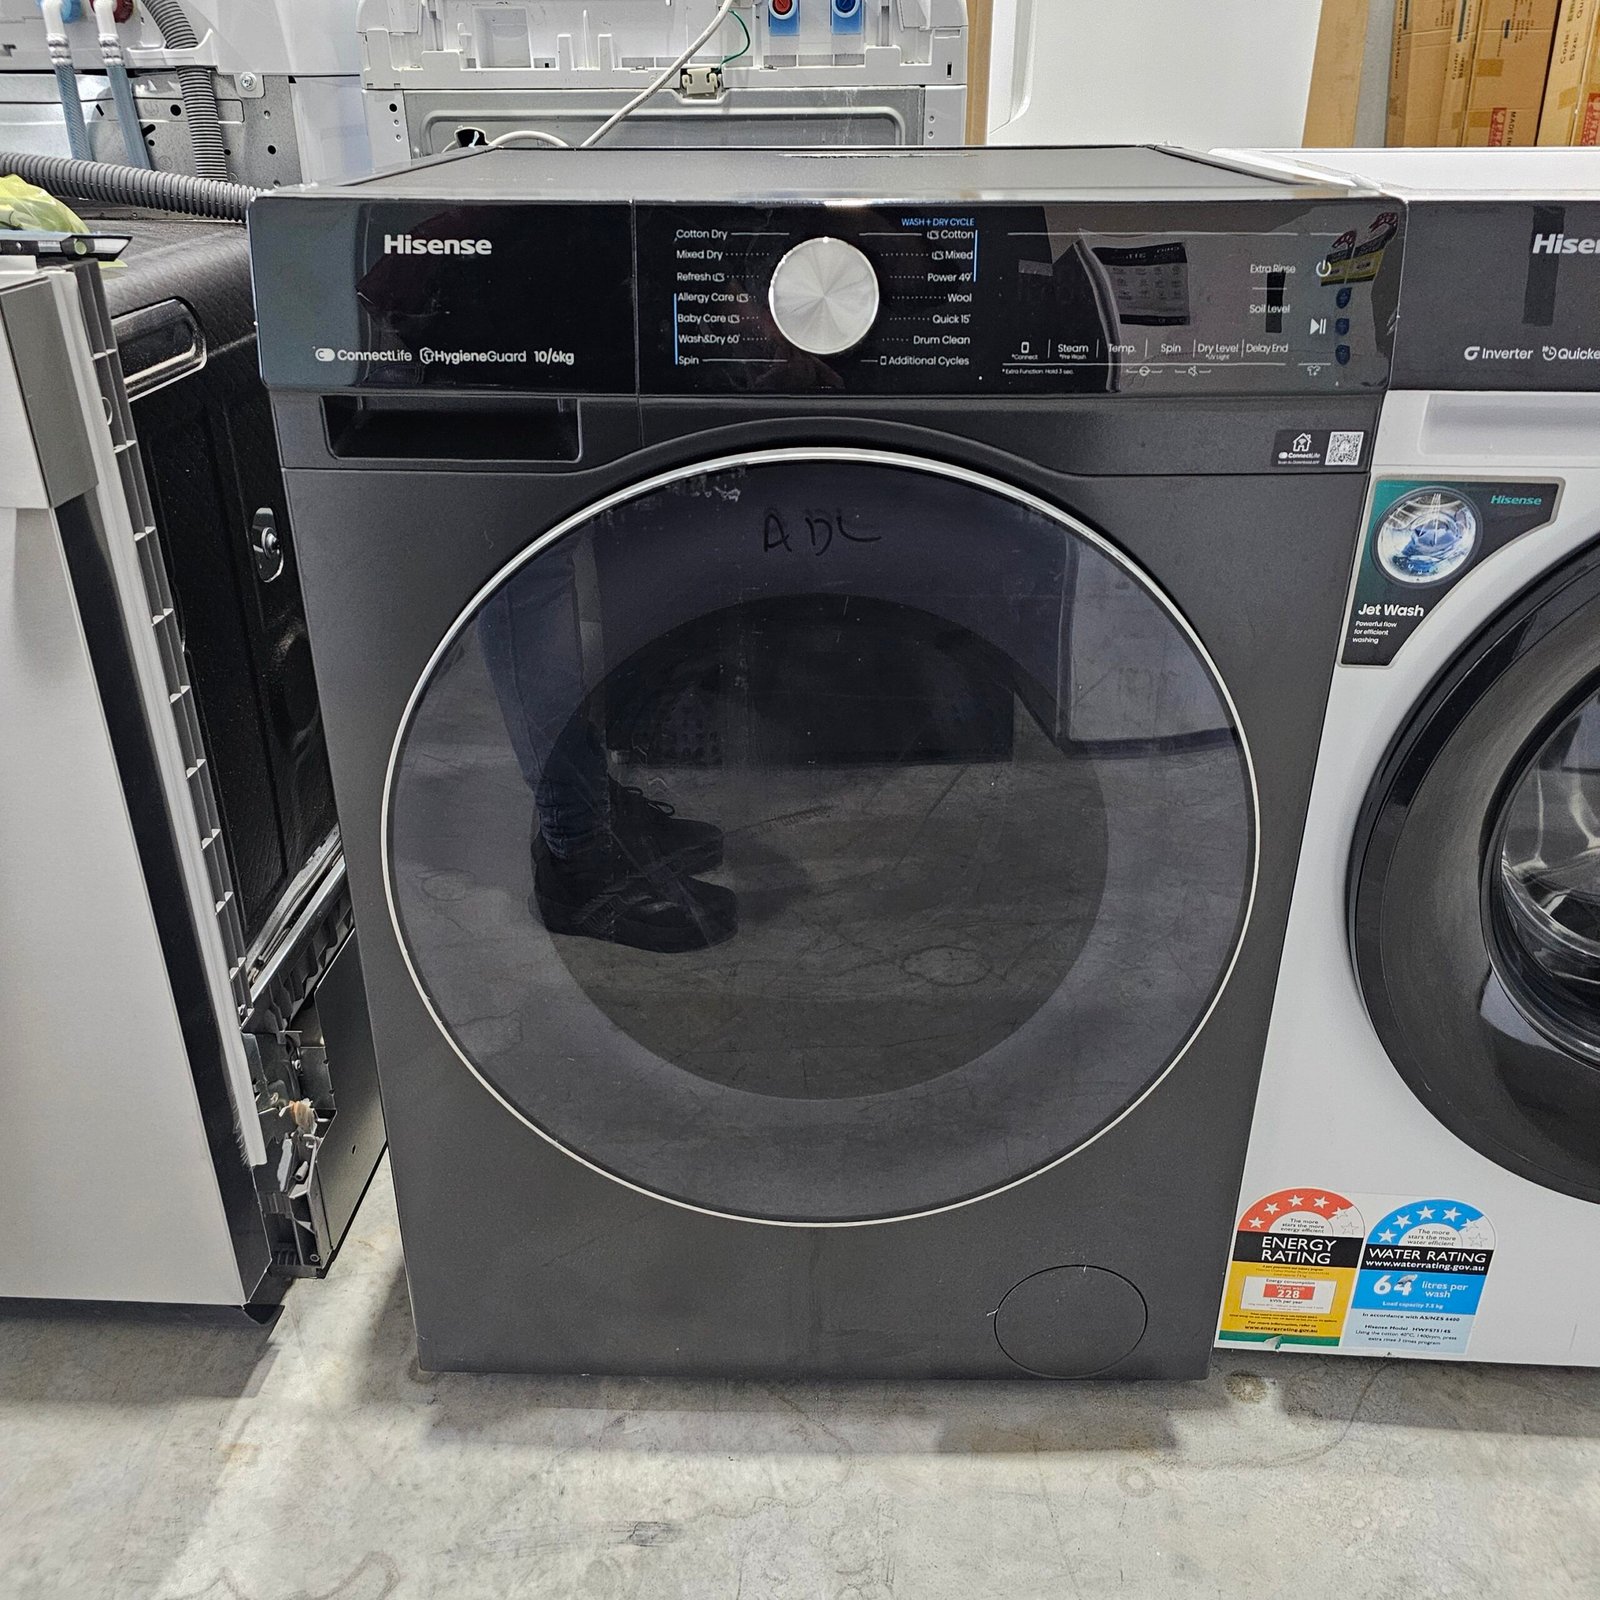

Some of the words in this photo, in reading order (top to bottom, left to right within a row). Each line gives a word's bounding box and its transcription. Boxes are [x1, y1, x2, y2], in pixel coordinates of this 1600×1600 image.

[901, 218, 925, 226] WASH
[932, 218, 949, 226] DRY
[949, 218, 975, 226] CYCLE
[676, 229, 709, 239] Cotton
[711, 229, 728, 240] Dry
[940, 230, 974, 239] Cotton
[384, 234, 493, 255] Hisense
[676, 250, 704, 259] Mixed
[706, 250, 723, 261] Dry
[945, 250, 974, 260] Mixed
[1250, 264, 1272, 274] Extra
[1272, 263, 1296, 274] Rinse
[676, 272, 711, 281] Refresh
[927, 272, 957, 282] Power
[677, 293, 710, 304] Allergy
[711, 293, 734, 301] Care
[947, 293, 972, 303] Wool
[1249, 304, 1266, 313] Soil
[1267, 304, 1290, 313] Level
[677, 314, 701, 324] Baby
[703, 314, 726, 323] Care
[932, 314, 959, 324] Quick
[678, 334, 725, 345] Wash&Dry
[913, 335, 940, 345] Drum
[941, 335, 970, 345] Clean
[1057, 343, 1089, 353] Steam
[1108, 343, 1136, 355] Temp.
[1160, 343, 1182, 355] Spin
[1197, 343, 1214, 354] Dry
[1215, 343, 1239, 353] Level
[1246, 343, 1270, 355] Delay
[1271, 343, 1289, 353] End
[1482, 348, 1533, 359] Inverter
[337, 350, 412, 362] ConnectLife
[435, 350, 527, 365] HygieneGuard
[533, 348, 575, 365] 10/6kg
[678, 356, 699, 366] Spin
[888, 356, 936, 365] Additional
[938, 356, 969, 367] Cycles
[1490, 495, 1542, 506] Hisense
[1358, 603, 1381, 616] Jet
[1384, 604, 1425, 617] Wash
[1355, 620, 1383, 628] Powerful
[1352, 637, 1379, 645] washing
[1261, 1236, 1337, 1252] ENERGY
[1261, 1249, 1331, 1264] RATING
[1369, 1248, 1420, 1260] WATER
[1427, 1250, 1487, 1263] RATING
[1365, 1260, 1485, 1272] www.waterrating.gov.au
[1422, 1281, 1448, 1290] litres
[1450, 1284, 1468, 1292] per
[1277, 1290, 1300, 1298] 228
[1425, 1290, 1451, 1298] wash
